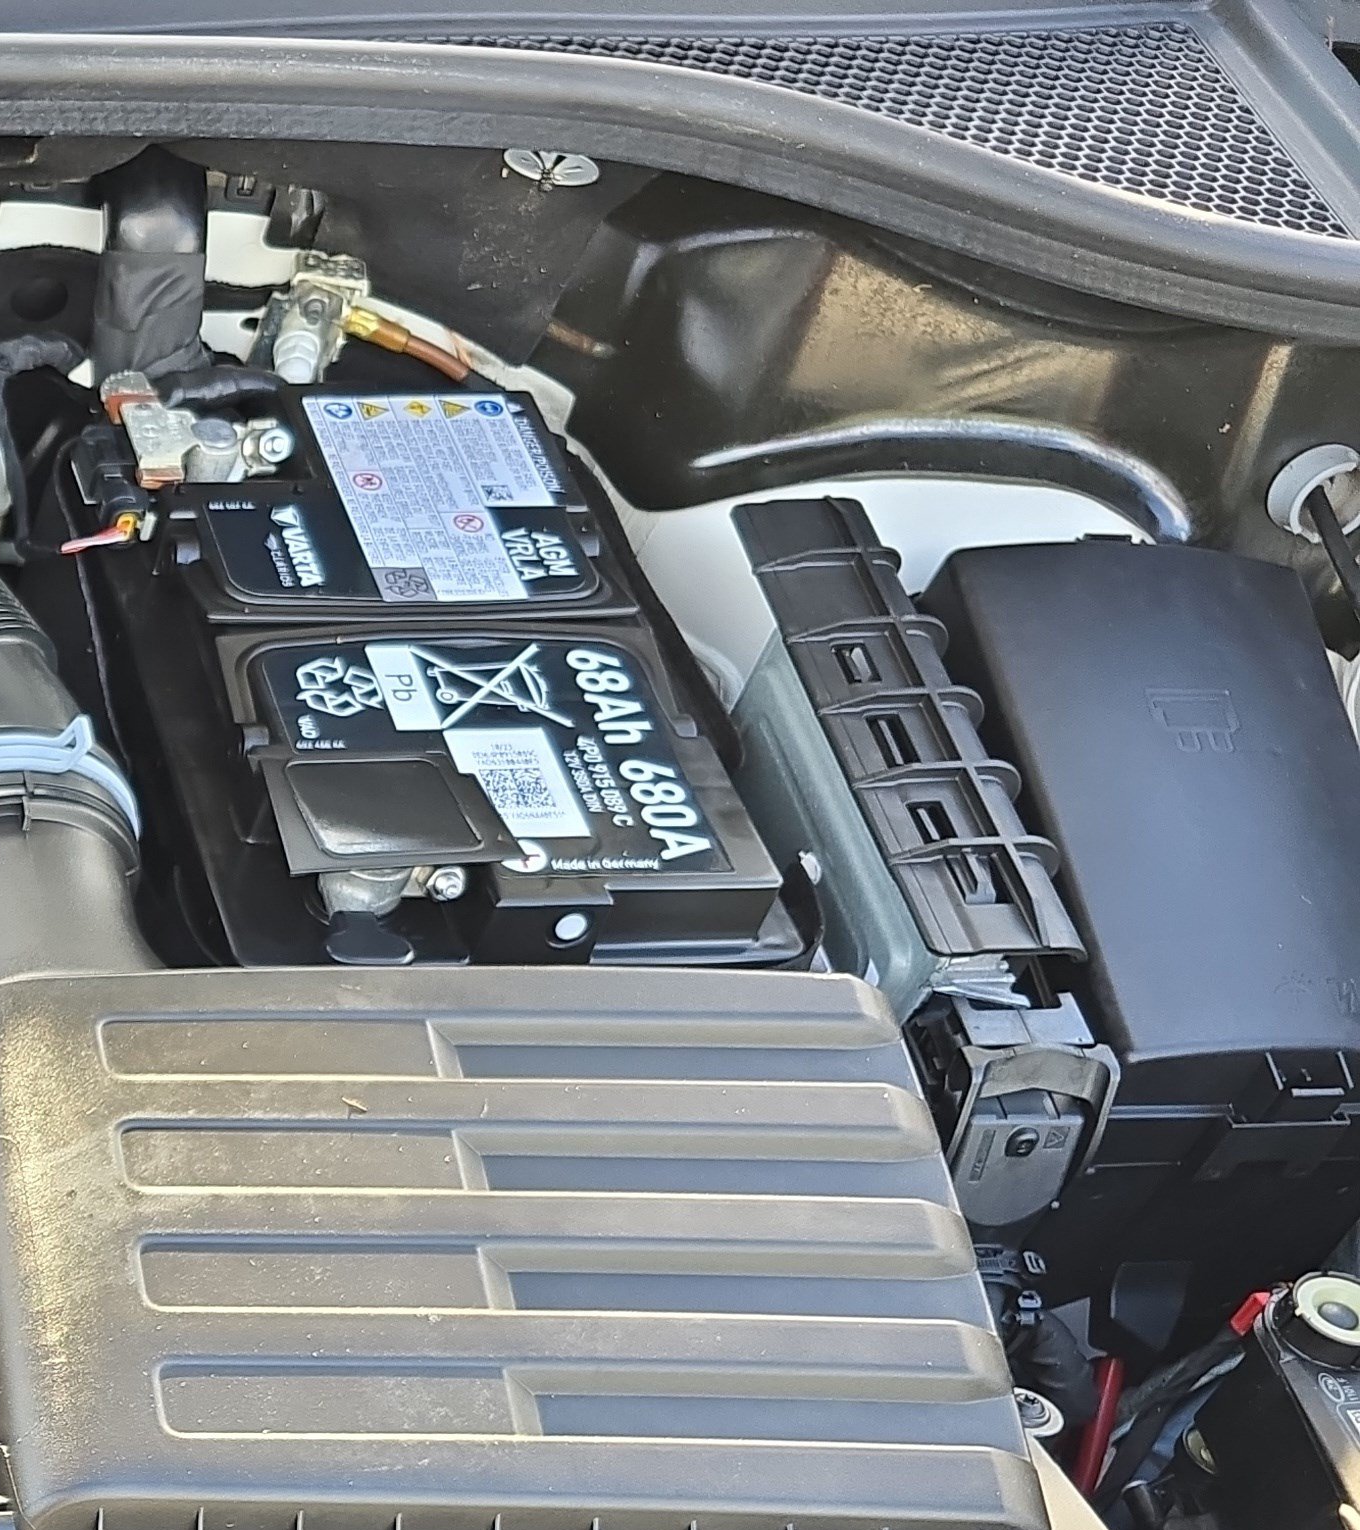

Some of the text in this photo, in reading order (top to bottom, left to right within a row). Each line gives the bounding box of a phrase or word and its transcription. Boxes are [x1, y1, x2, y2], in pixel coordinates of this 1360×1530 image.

[281, 526, 324, 587] VARTA
[501, 527, 548, 581] VRLA
[530, 530, 580, 576] AGM
[384, 674, 417, 702] Pb
[566, 649, 711, 861] 68Ah 680A
[613, 814, 634, 828] C
[550, 856, 659, 870] Made in Germany
